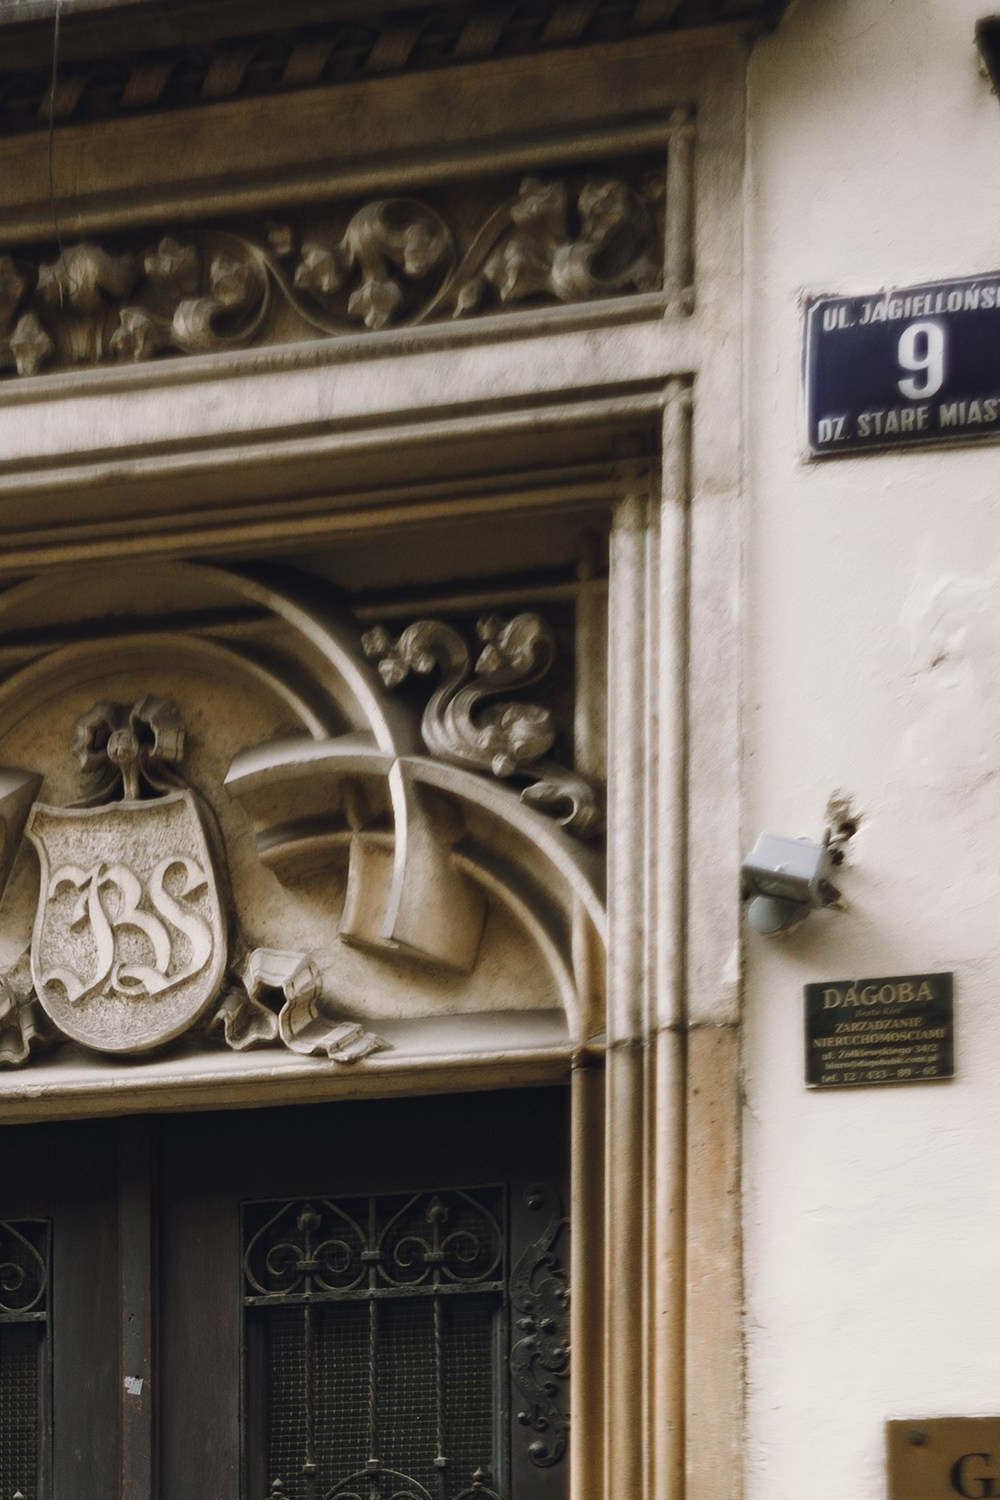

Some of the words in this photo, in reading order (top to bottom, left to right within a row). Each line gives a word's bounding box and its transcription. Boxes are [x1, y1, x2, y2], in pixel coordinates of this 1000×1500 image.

[822, 306, 855, 332] UL.
[897, 322, 944, 400] 9
[817, 415, 852, 444] DZ.
[857, 406, 929, 438] STARE
[939, 398, 1000, 428] MIAS
[822, 979, 936, 1010] DAGOBA
[834, 1016, 922, 1034] ZARZĄDZANIE
[843, 1072, 857, 1082] 12
